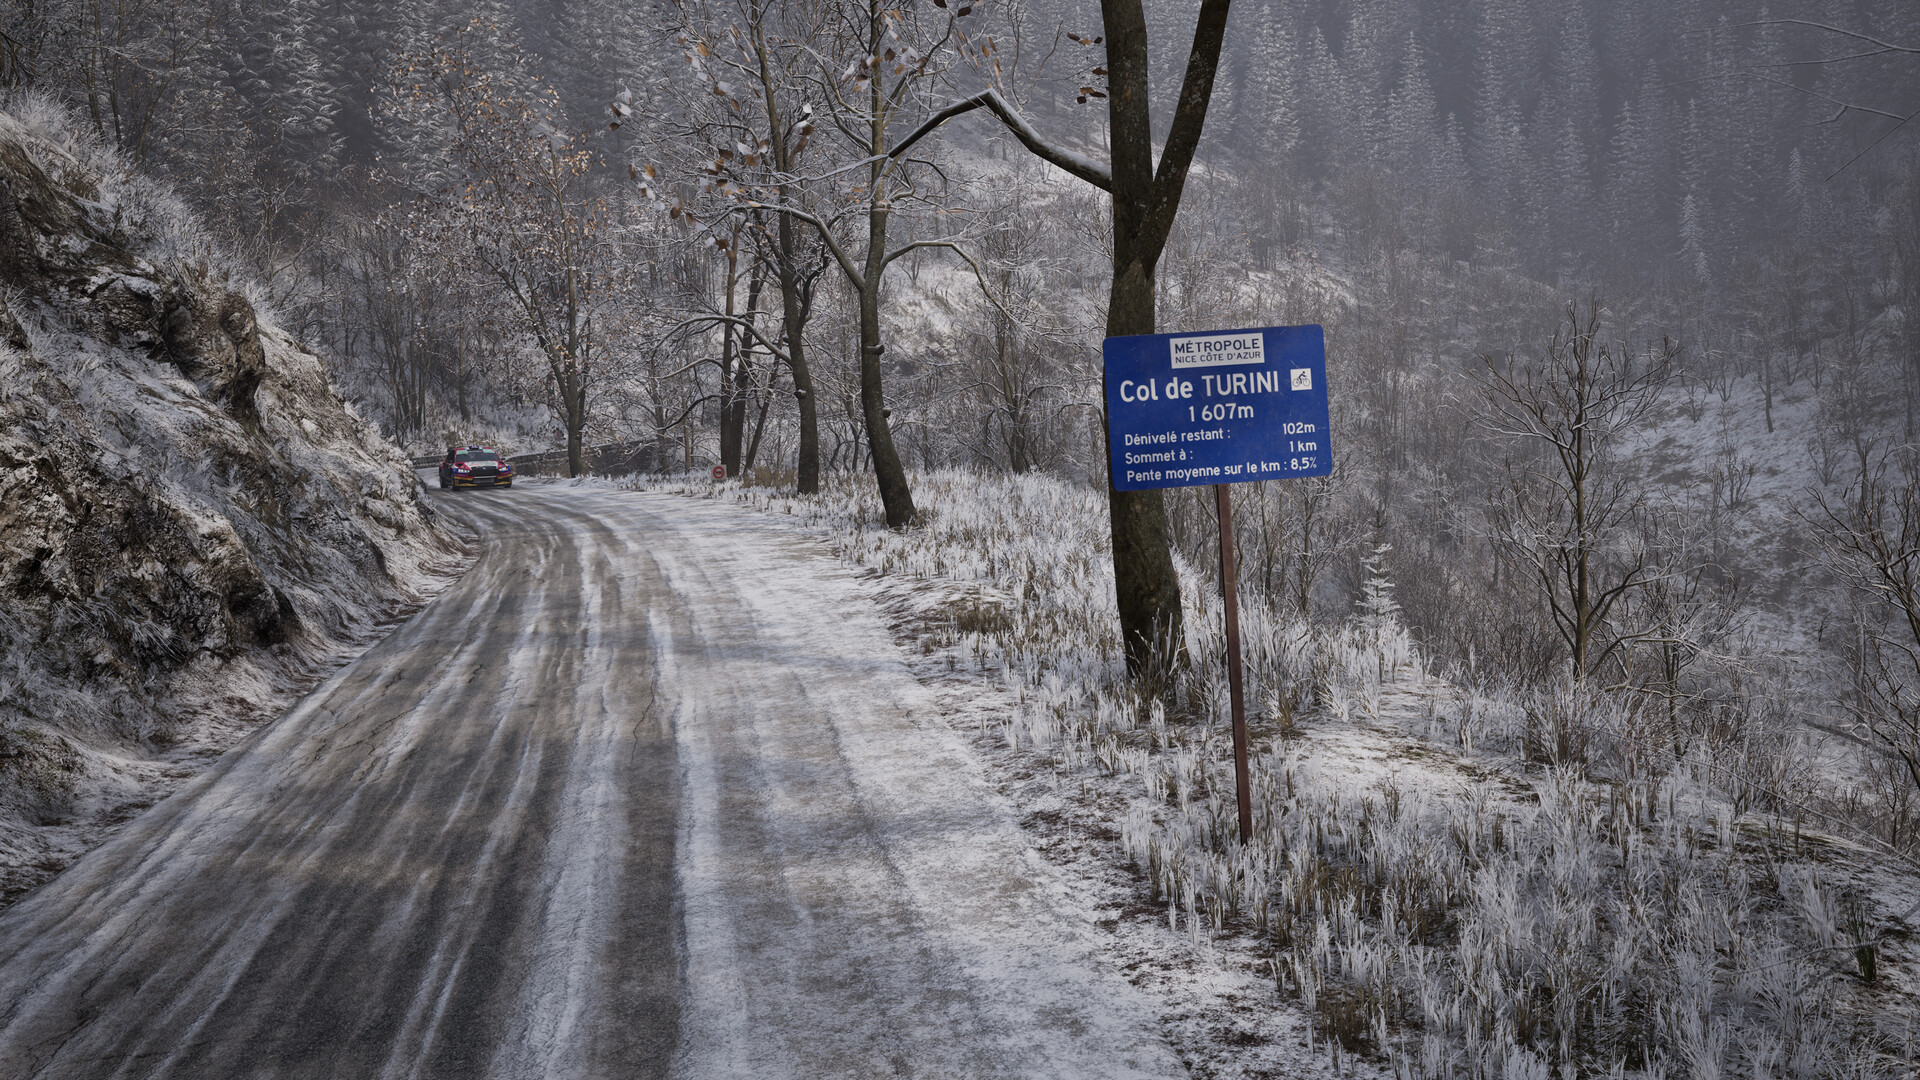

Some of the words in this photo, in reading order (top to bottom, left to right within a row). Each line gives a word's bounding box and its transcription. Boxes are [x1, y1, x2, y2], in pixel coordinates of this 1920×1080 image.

[1175, 338, 1260, 353] MÉTROPOLE
[1200, 353, 1224, 362] CÔTE
[1227, 351, 1261, 360] D'AZUR
[1120, 378, 1158, 402] Col
[1166, 377, 1193, 399] de
[1202, 371, 1279, 397] TURINI
[1125, 431, 1177, 446] Dénivelé
[1181, 428, 1223, 442] restant
[1283, 422, 1315, 435] 102m
[1125, 451, 1175, 464] Sommet
[1179, 449, 1186, 460] à
[1298, 441, 1317, 452] km
[1127, 470, 1161, 482] Pente
[1166, 465, 1220, 481] moyenne
[1224, 464, 1242, 475] sur
[1247, 461, 1257, 472] le
[1261, 460, 1280, 472] km
[1291, 457, 1317, 471] 8,5%
